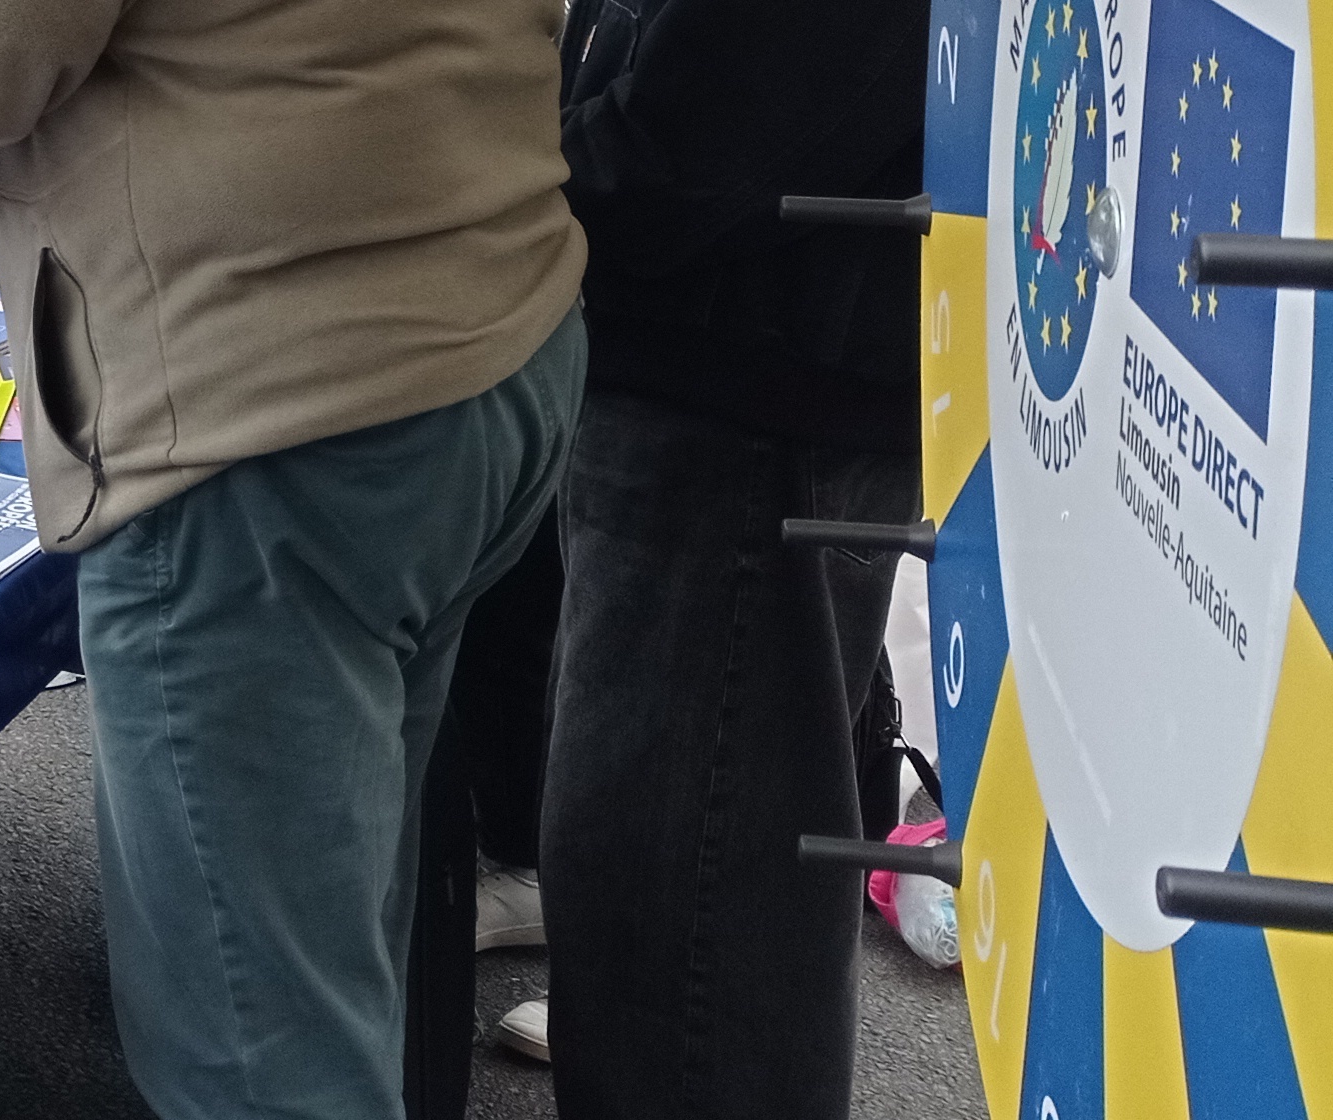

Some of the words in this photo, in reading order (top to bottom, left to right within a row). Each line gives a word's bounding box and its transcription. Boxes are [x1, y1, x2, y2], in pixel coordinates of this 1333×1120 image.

[937, 25, 959, 105] 2
[1005, 300, 1023, 383] EN
[1019, 370, 1087, 475] LIMOUSIN
[1117, 394, 1182, 511] Limousin
[1121, 333, 1190, 459] EUROPE
[1190, 412, 1265, 542] DIRECT
[1114, 449, 1248, 662] Nouvelle-Aquitaine
